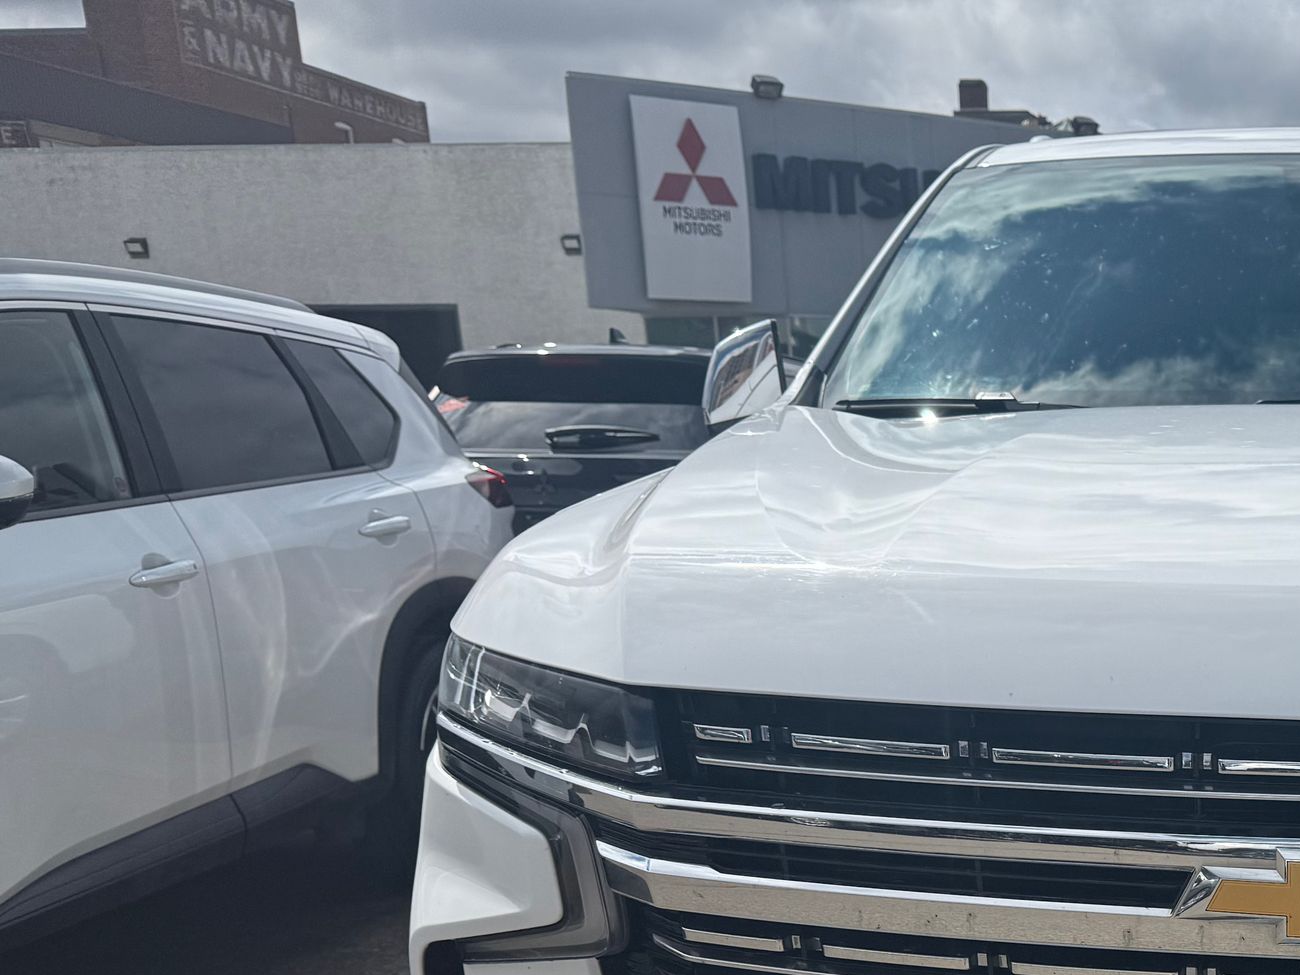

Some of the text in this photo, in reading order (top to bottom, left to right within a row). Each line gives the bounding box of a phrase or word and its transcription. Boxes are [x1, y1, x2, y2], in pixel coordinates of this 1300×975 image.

[203, 27, 292, 88] NAVY
[327, 80, 425, 131] WAREHOUSE
[663, 205, 731, 222] MITSUBISHI
[674, 221, 723, 237] MOTORS
